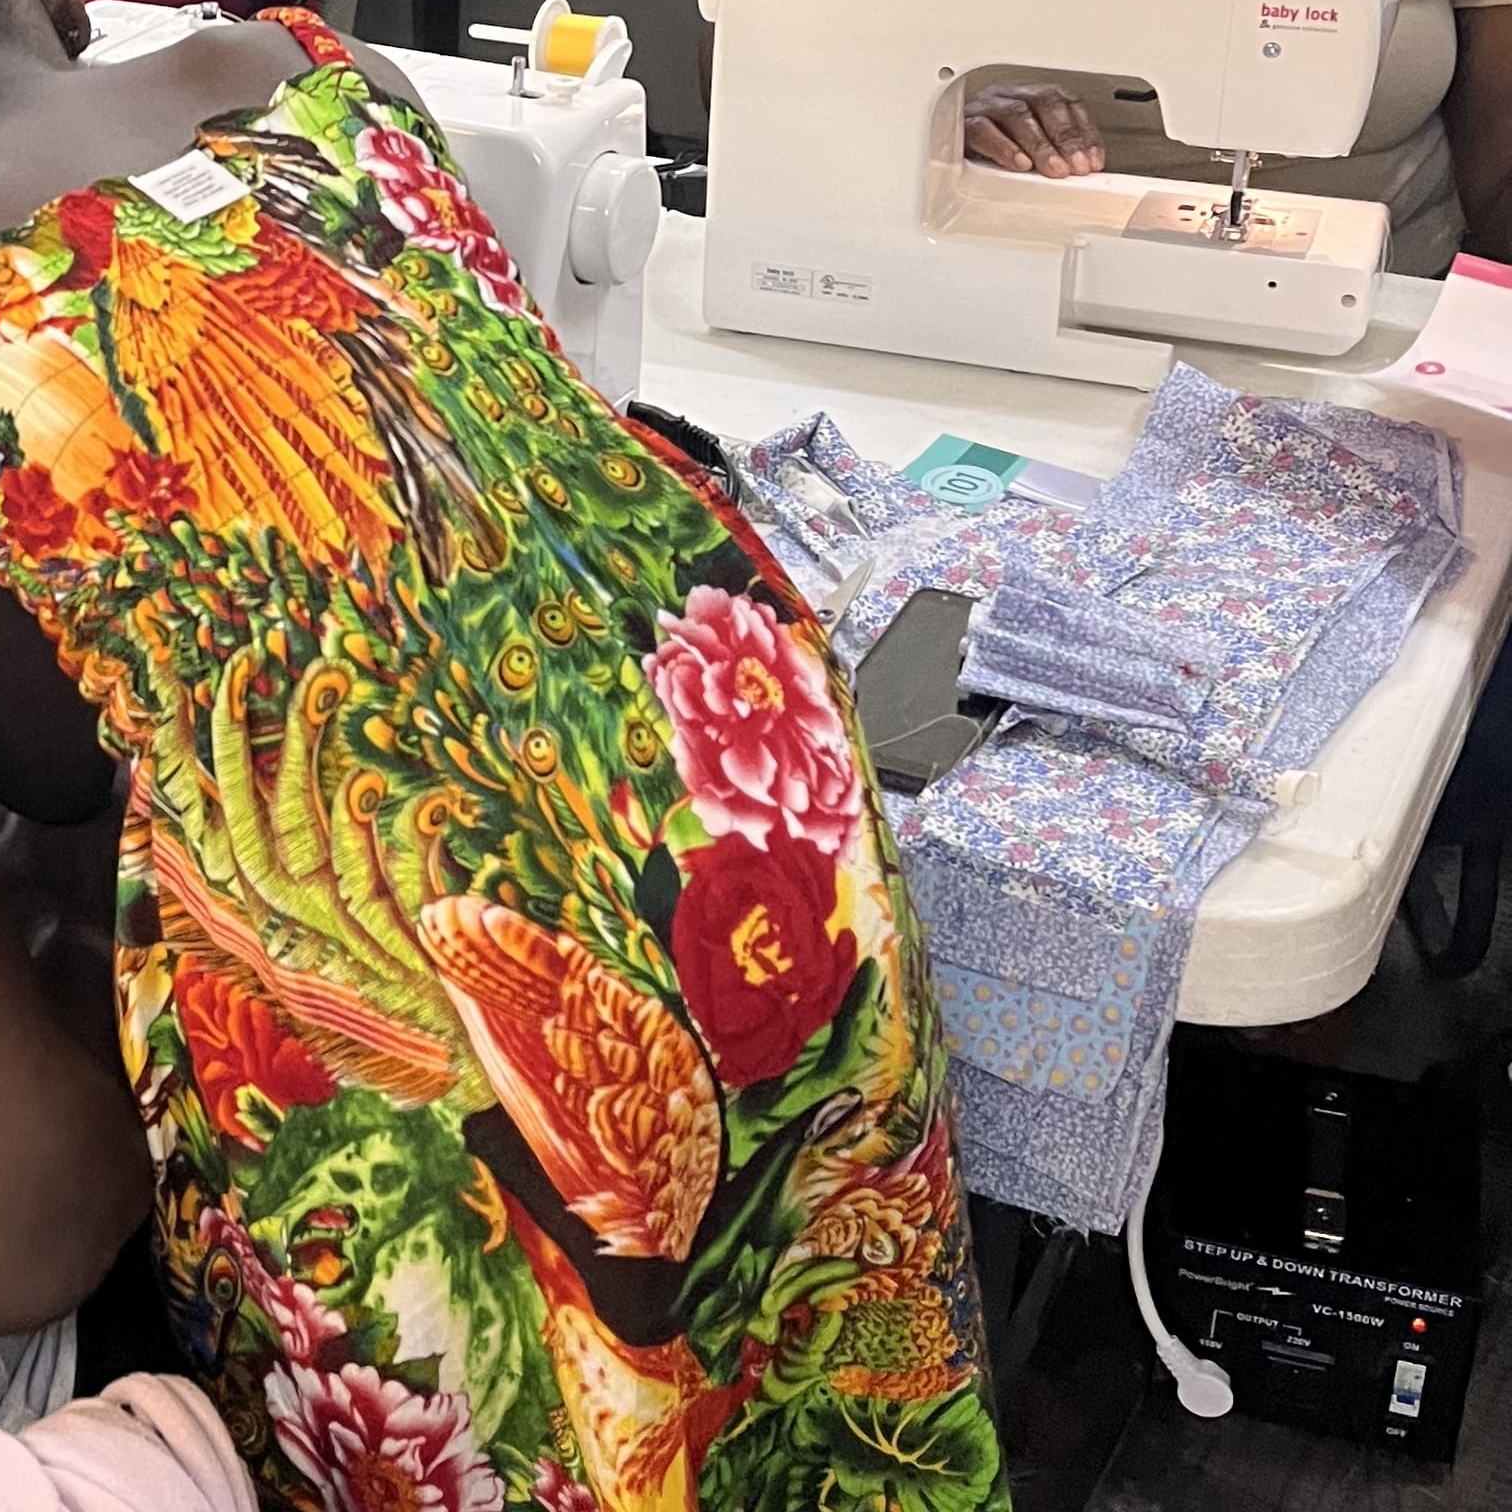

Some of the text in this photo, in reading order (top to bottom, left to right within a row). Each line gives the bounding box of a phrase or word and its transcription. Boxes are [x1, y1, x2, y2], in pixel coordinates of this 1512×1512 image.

[1261, 2, 1339, 23] baby lock
[939, 472, 987, 496] 101
[1184, 1239, 1463, 1308] STEP UP & DOWN TRANSFORMER
[1236, 1312, 1280, 1329] OUTPUT
[1402, 1341, 1421, 1352] ON
